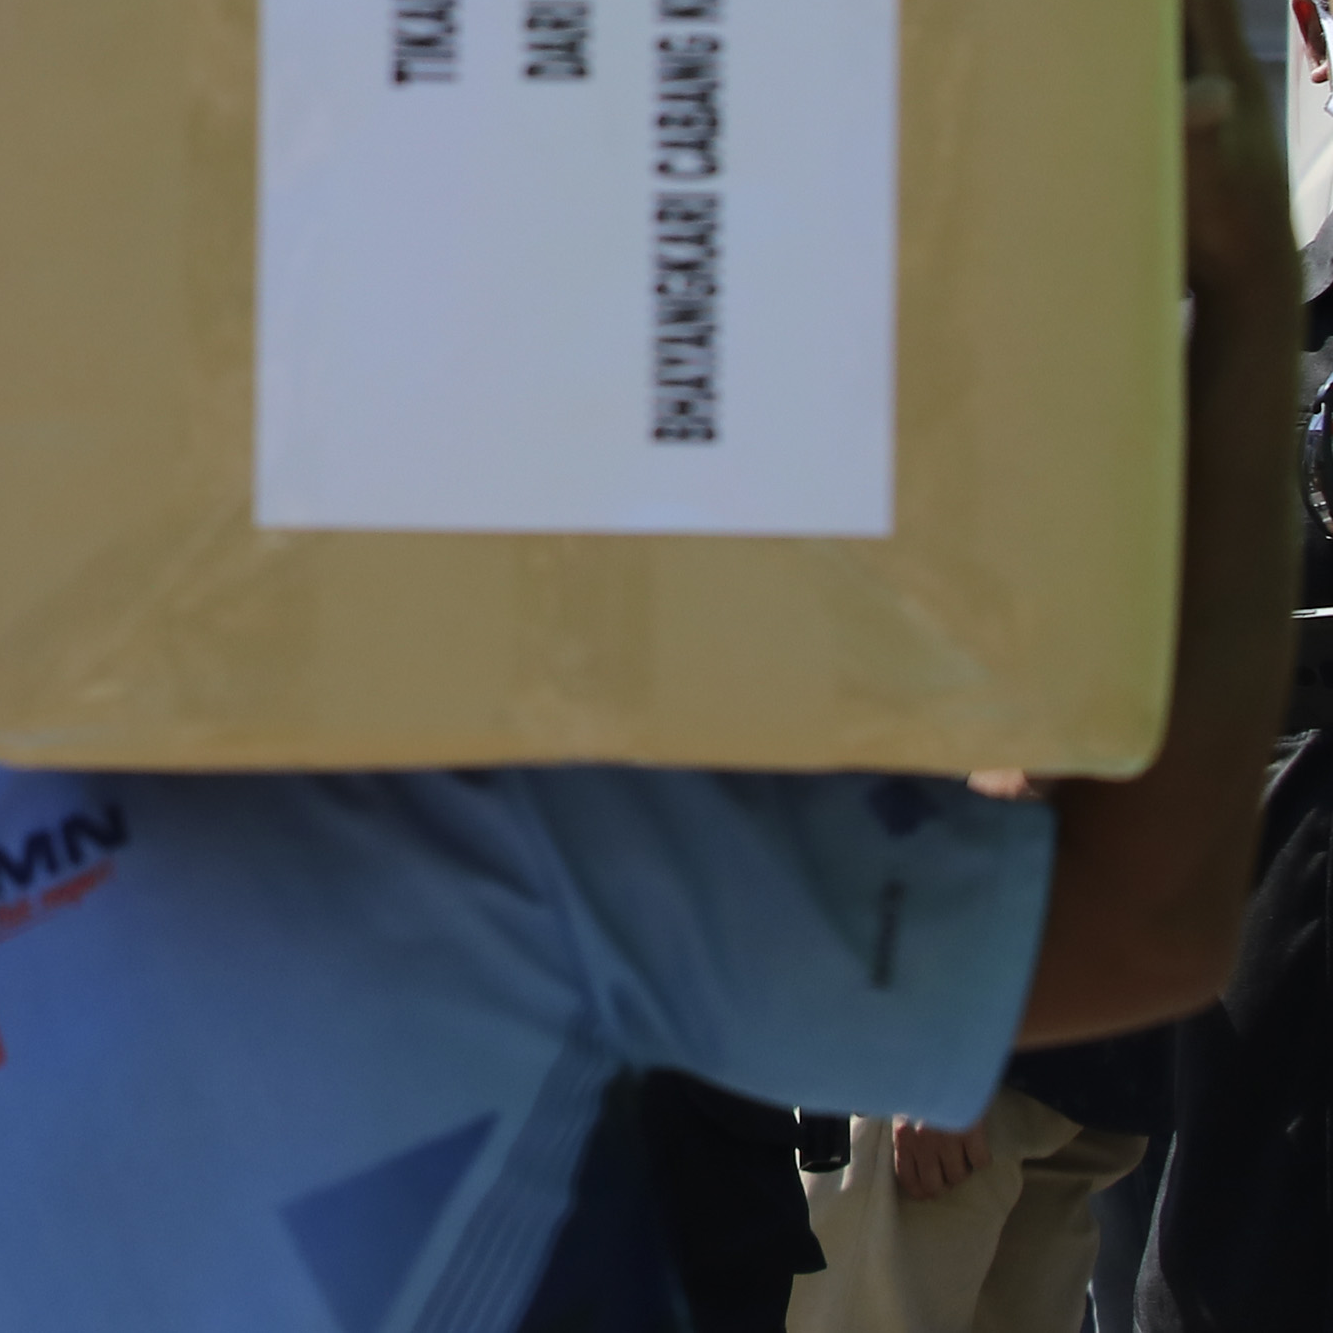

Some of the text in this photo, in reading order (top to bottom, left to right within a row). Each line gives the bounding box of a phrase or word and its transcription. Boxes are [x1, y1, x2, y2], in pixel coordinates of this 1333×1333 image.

[523, 0, 591, 81] DARI
[654, 34, 722, 179] CABANG
[651, 193, 719, 445] BHAYANGKARI
